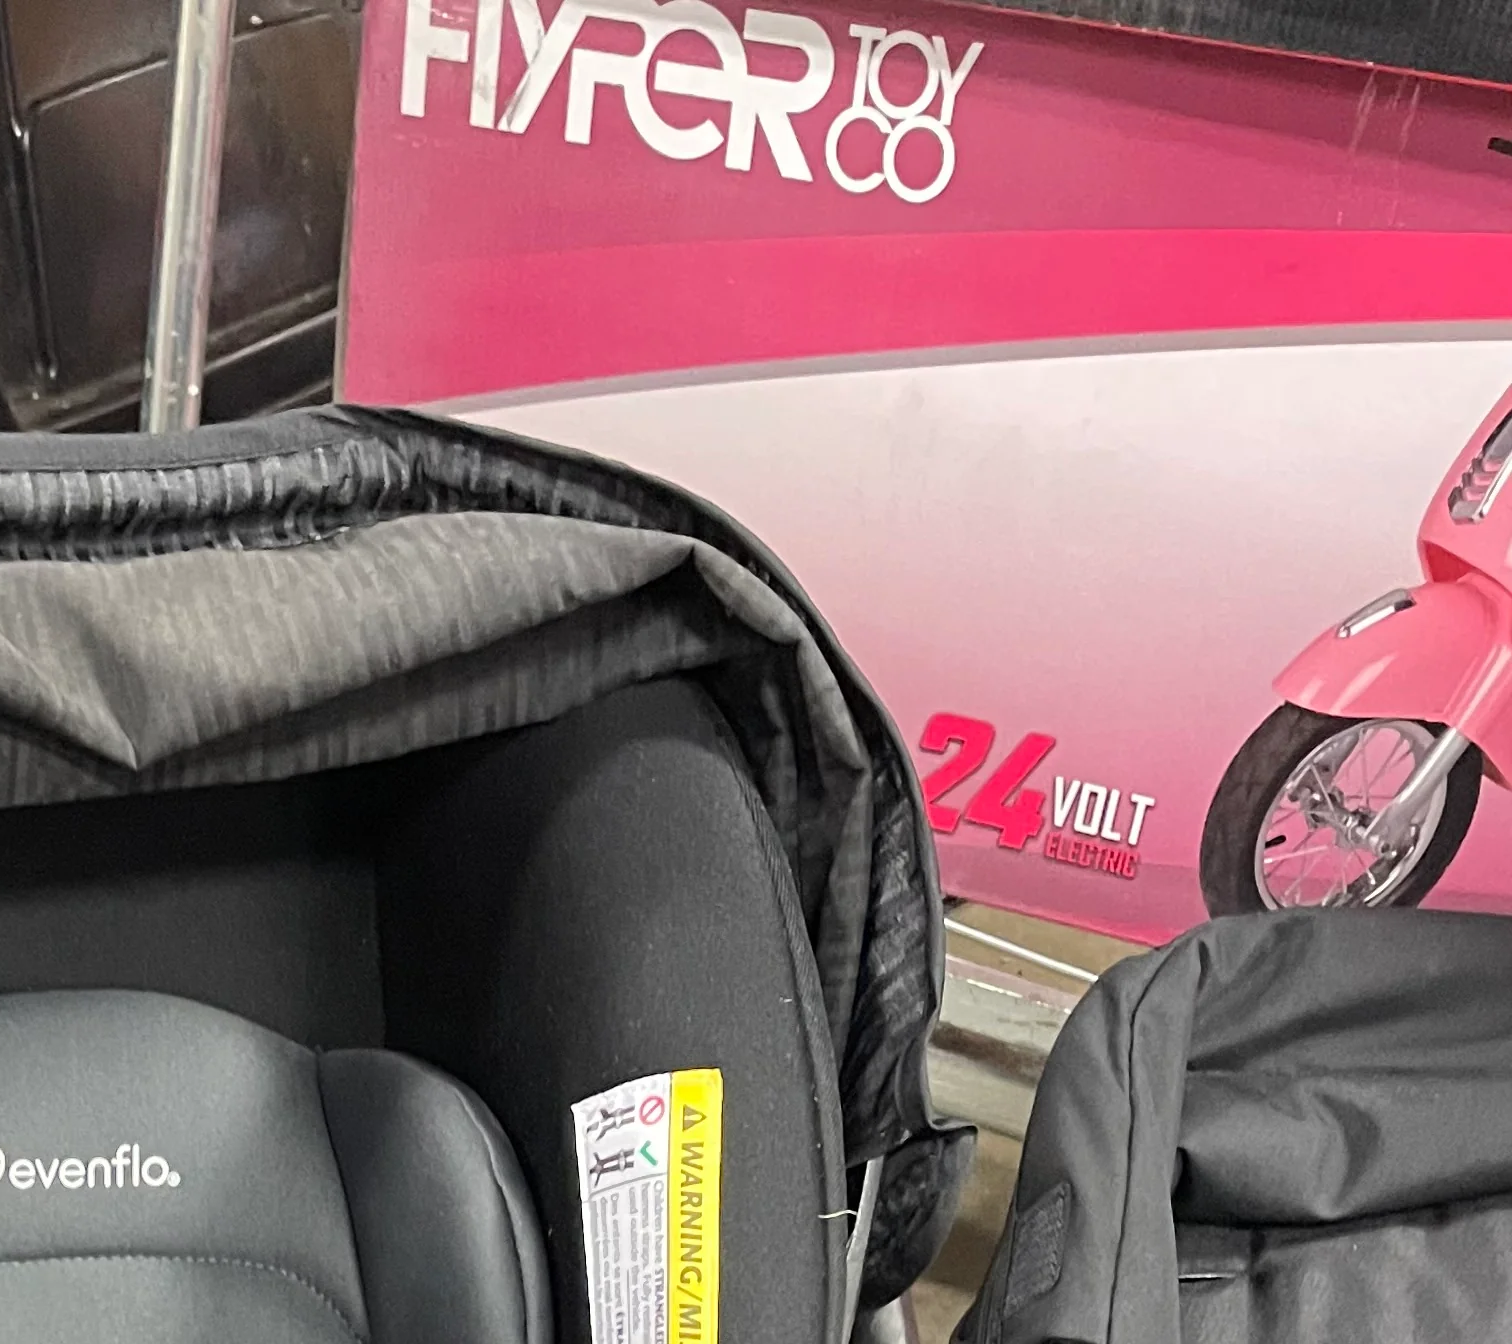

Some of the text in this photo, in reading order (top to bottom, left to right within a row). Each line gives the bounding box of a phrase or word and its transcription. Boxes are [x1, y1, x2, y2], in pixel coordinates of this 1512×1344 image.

[849, 23, 984, 125] TOY
[825, 105, 955, 203] CO
[919, 713, 1155, 849] 24 VOLT
[1044, 832, 1141, 880] ELECTRIC
